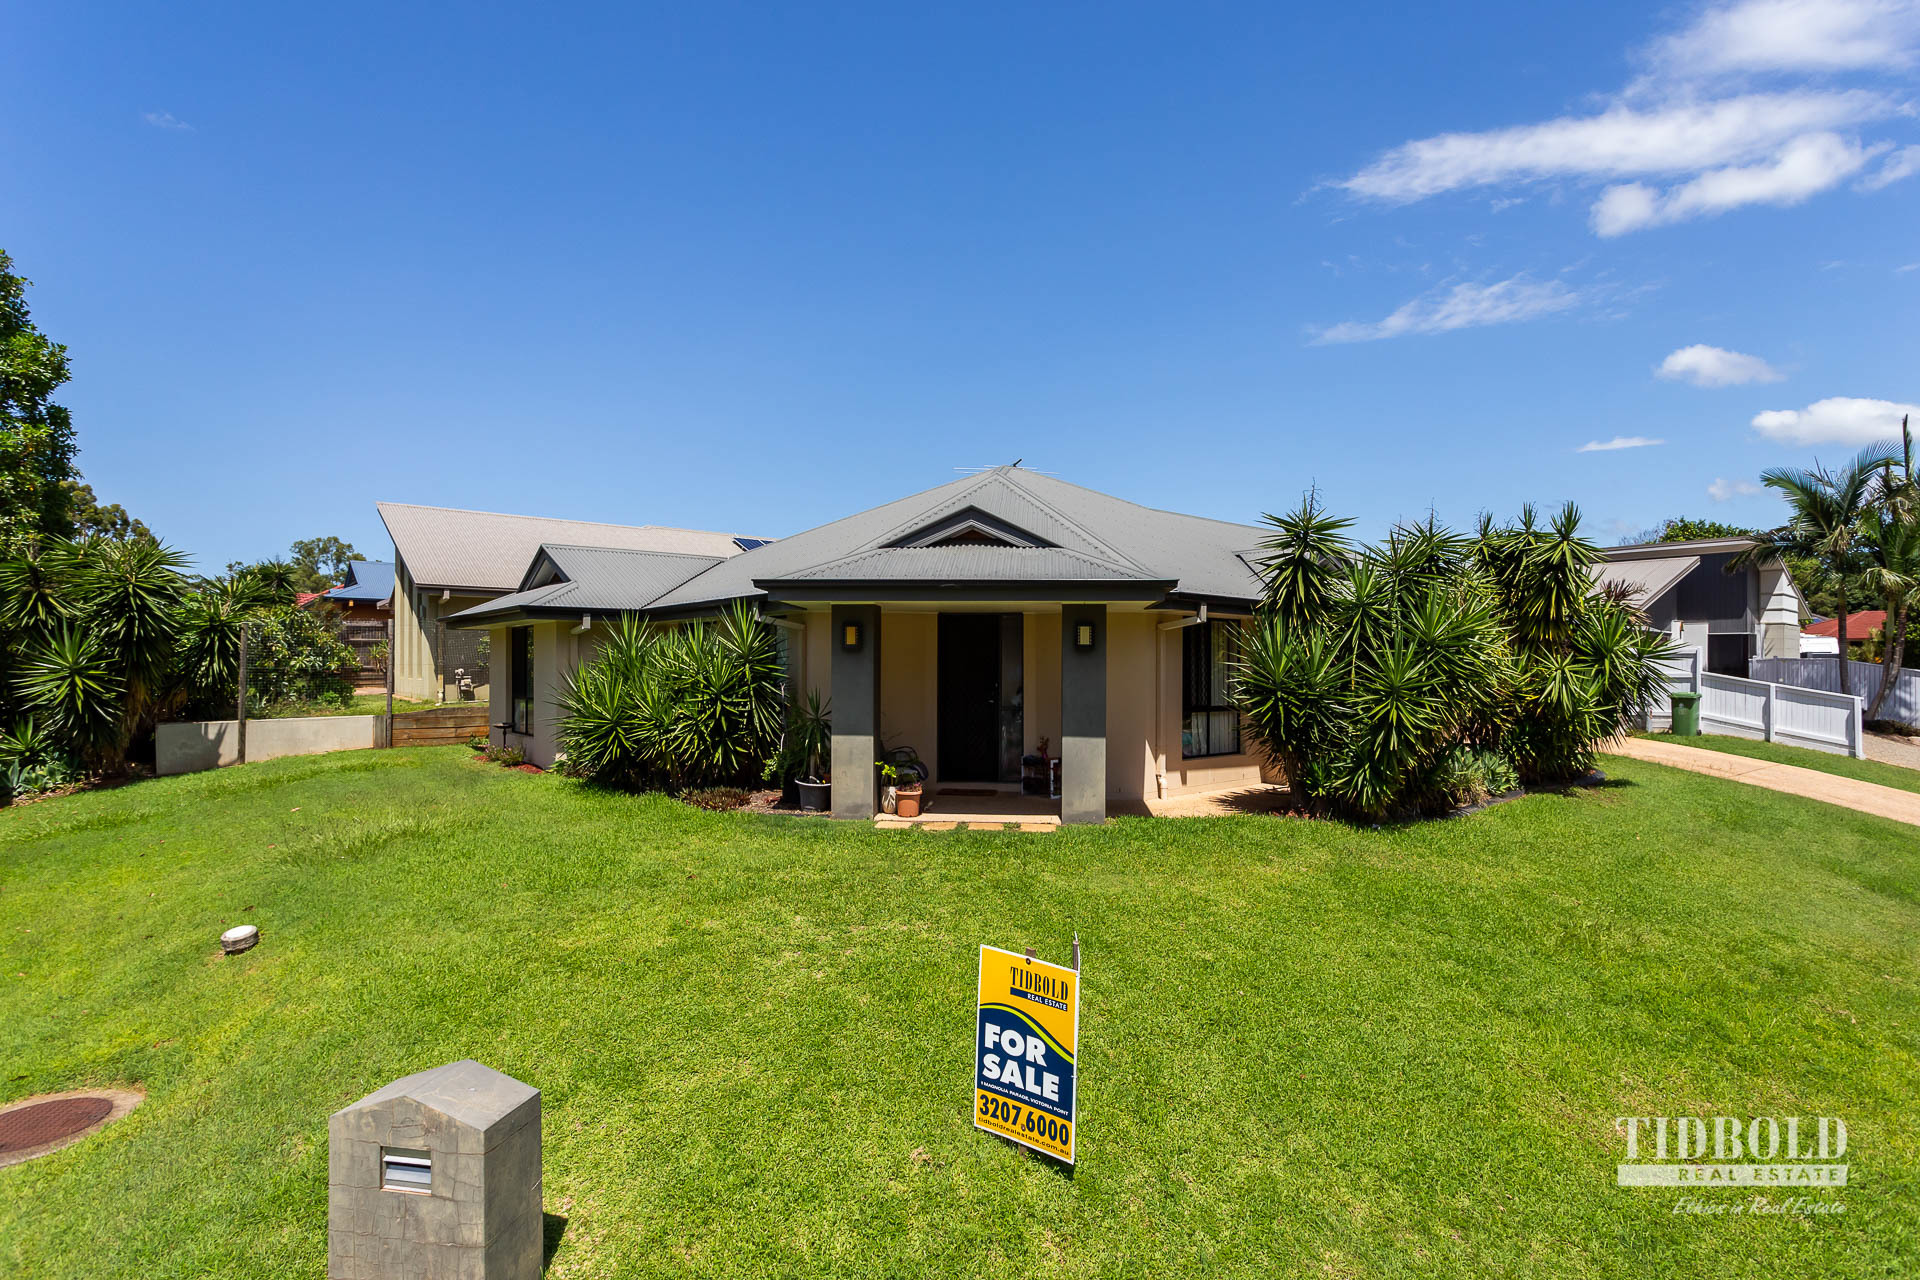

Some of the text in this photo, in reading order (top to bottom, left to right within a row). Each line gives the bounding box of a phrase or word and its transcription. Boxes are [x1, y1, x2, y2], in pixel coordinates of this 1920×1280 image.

[1010, 966, 1069, 1001] TIDBOLD
[1027, 993, 1067, 1010] REAL ESTATE
[984, 1021, 1048, 1067] FOR
[982, 1053, 1060, 1102] SALE
[984, 1082, 1009, 1094] MAGNOLIA
[1030, 1097, 1053, 1110] VICTORIA
[1053, 1107, 1069, 1116] POINT
[978, 1117, 1070, 1156] tidboldrealestate.com.au
